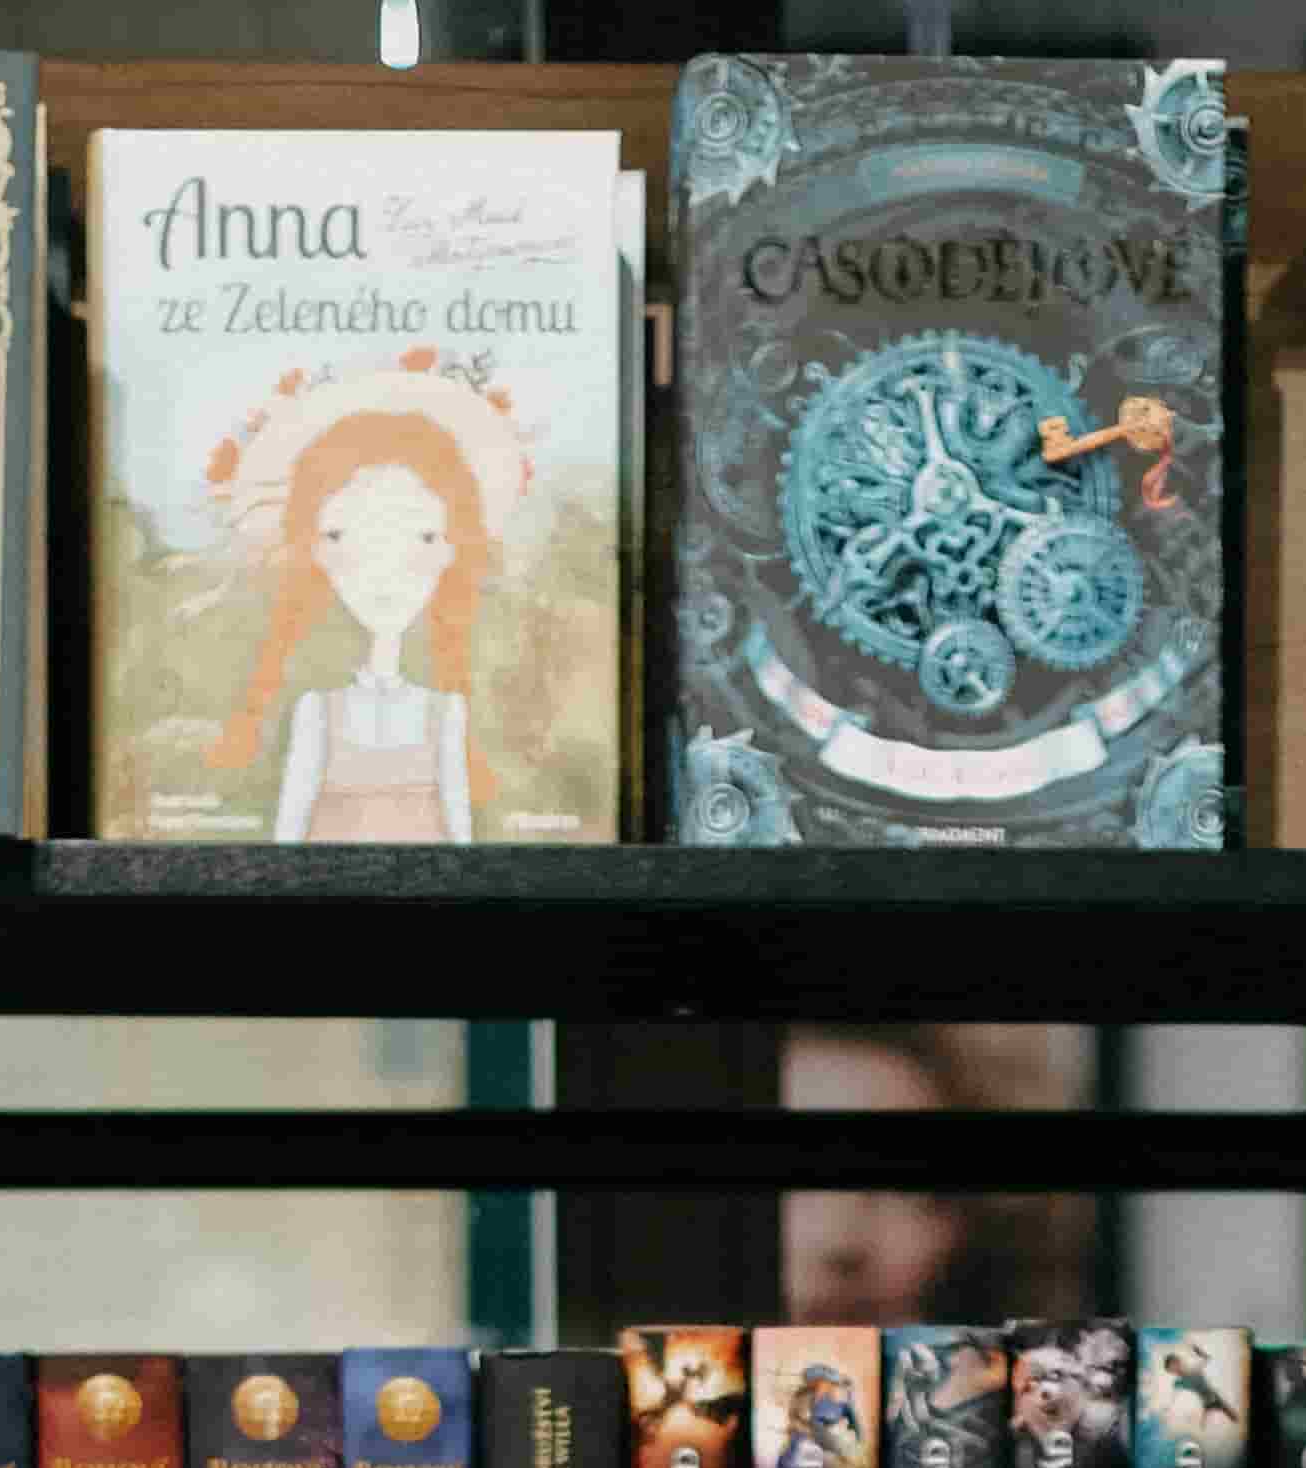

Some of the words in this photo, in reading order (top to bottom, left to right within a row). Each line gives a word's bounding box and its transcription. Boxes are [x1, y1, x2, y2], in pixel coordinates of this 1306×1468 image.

[141, 175, 368, 271] Anna
[157, 298, 208, 336] ze
[219, 282, 430, 336] Zeleného
[444, 287, 583, 336] domu
